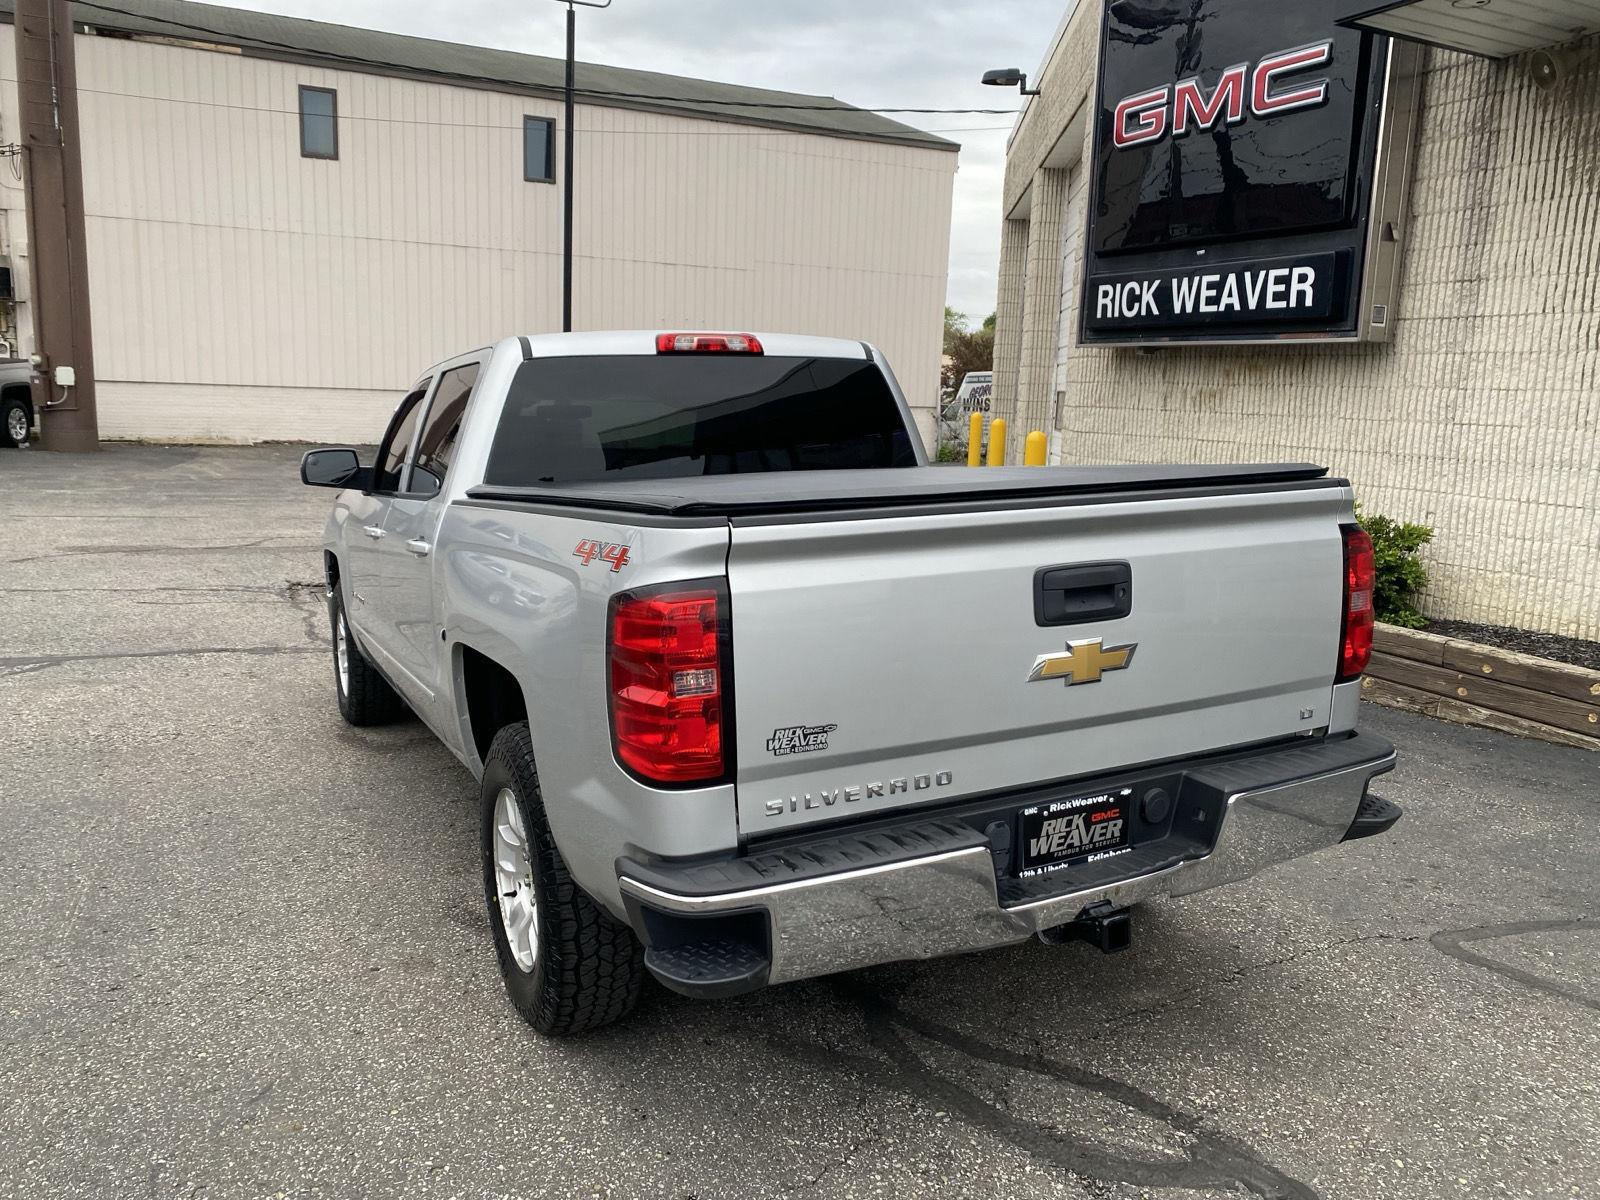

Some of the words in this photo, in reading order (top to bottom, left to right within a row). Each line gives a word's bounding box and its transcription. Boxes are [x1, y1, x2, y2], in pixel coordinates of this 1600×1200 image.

[1113, 39, 1333, 149] GMC
[1096, 280, 1161, 319] RICK
[1171, 266, 1316, 315] WEAVER
[767, 732, 828, 751] WEAVER
[774, 726, 805, 740] RICK
[765, 770, 953, 816] SILVERADO
[1024, 806, 1038, 816] GMC
[1040, 812, 1086, 837] RICK
[1091, 808, 1120, 823] GMC
[1030, 818, 1123, 857] WEAVER
[1054, 847, 1080, 858] FAMOUS
